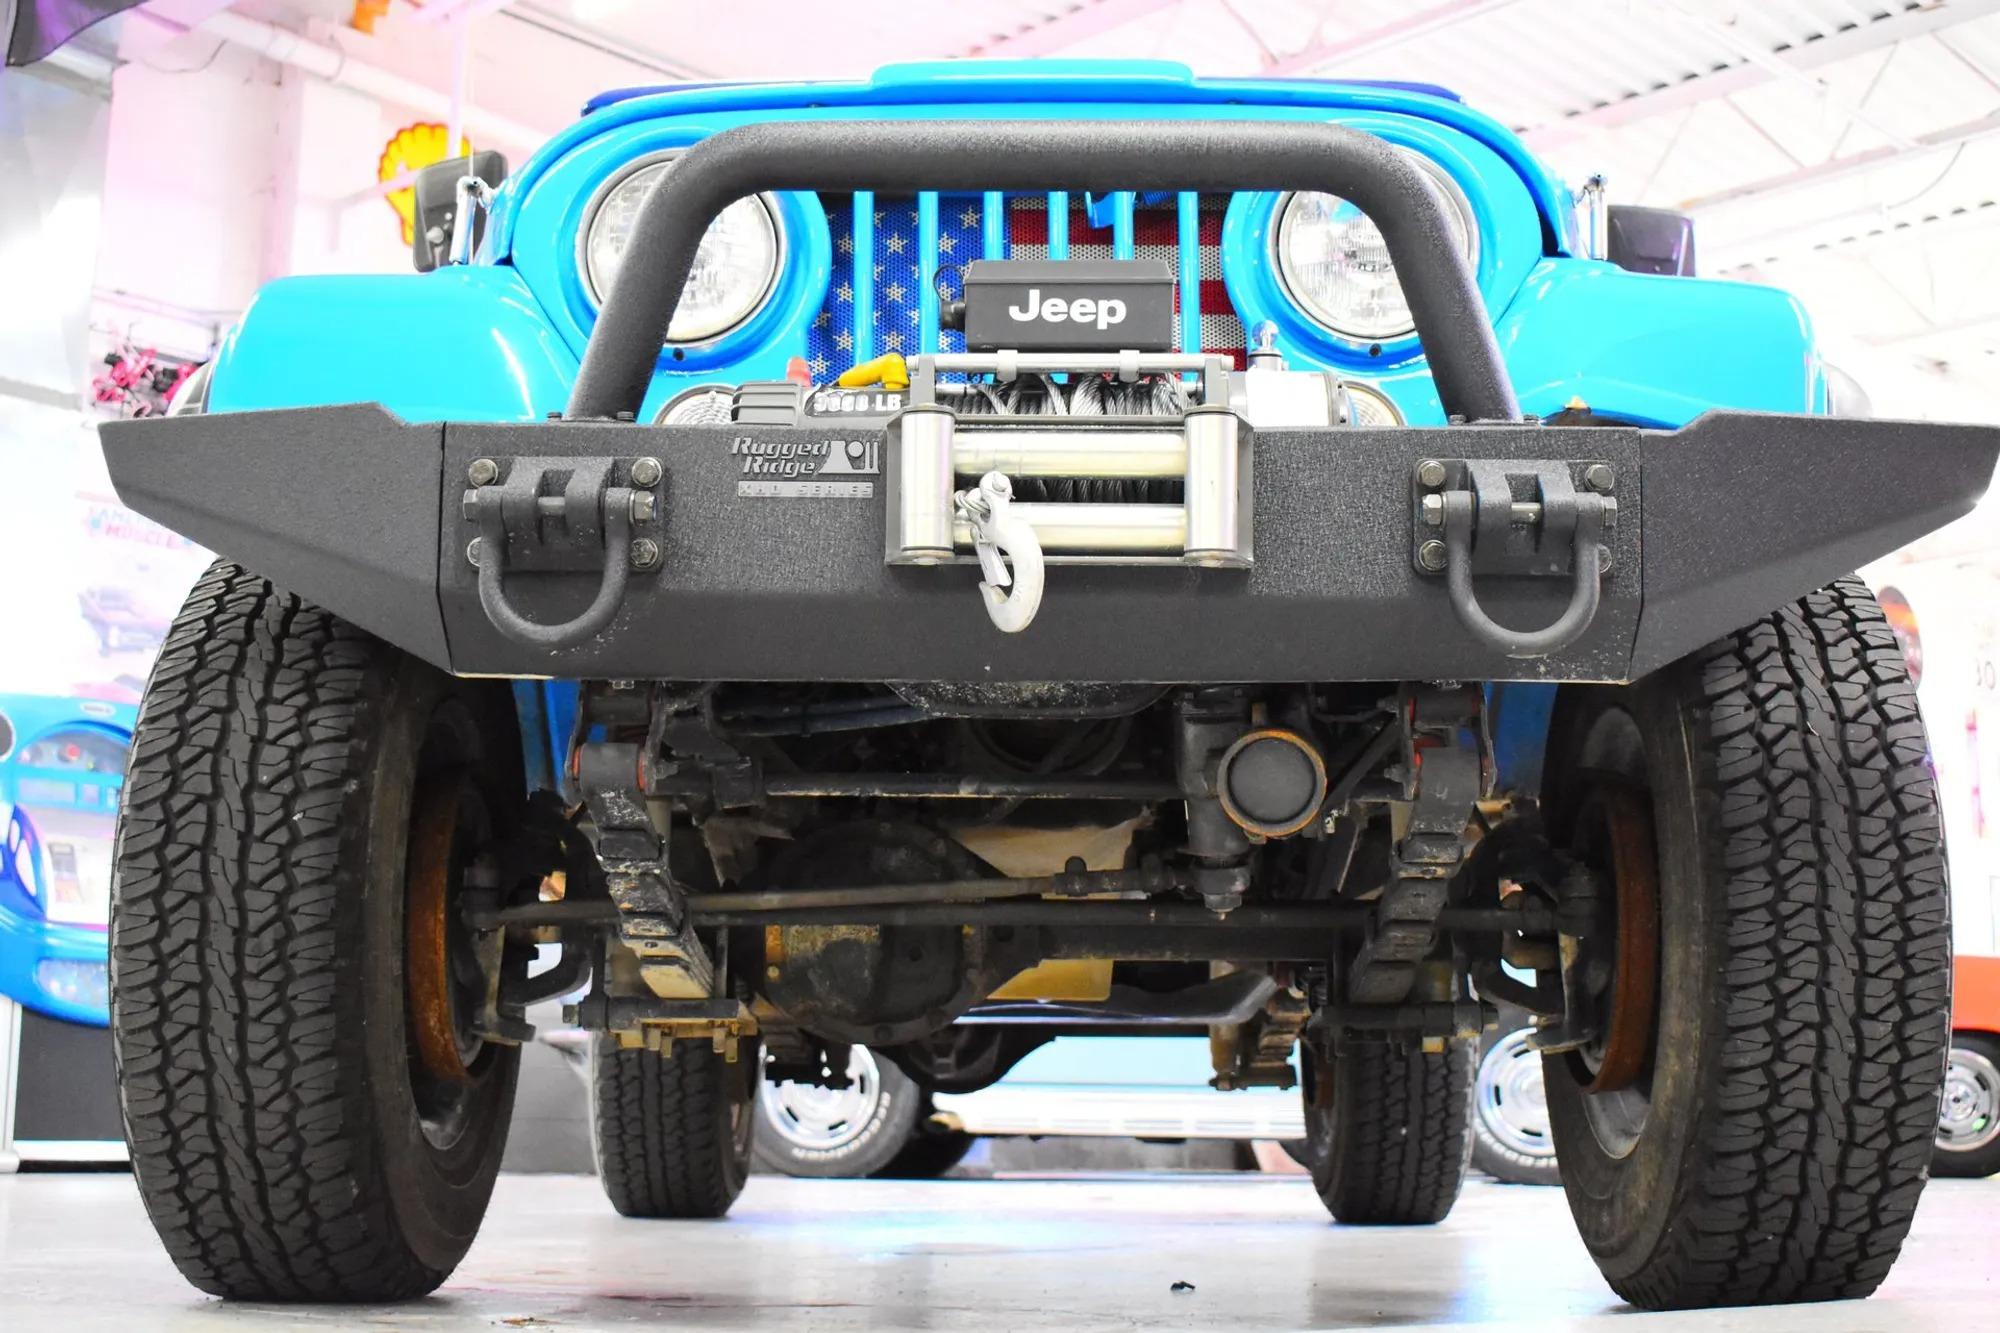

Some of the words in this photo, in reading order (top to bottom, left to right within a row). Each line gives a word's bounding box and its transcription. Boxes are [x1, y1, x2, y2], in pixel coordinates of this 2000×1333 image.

[1008, 288, 1127, 330] Jeep
[732, 437, 830, 459] Rugged
[743, 456, 816, 478] Ridge
[798, 483, 873, 497] SERIES
